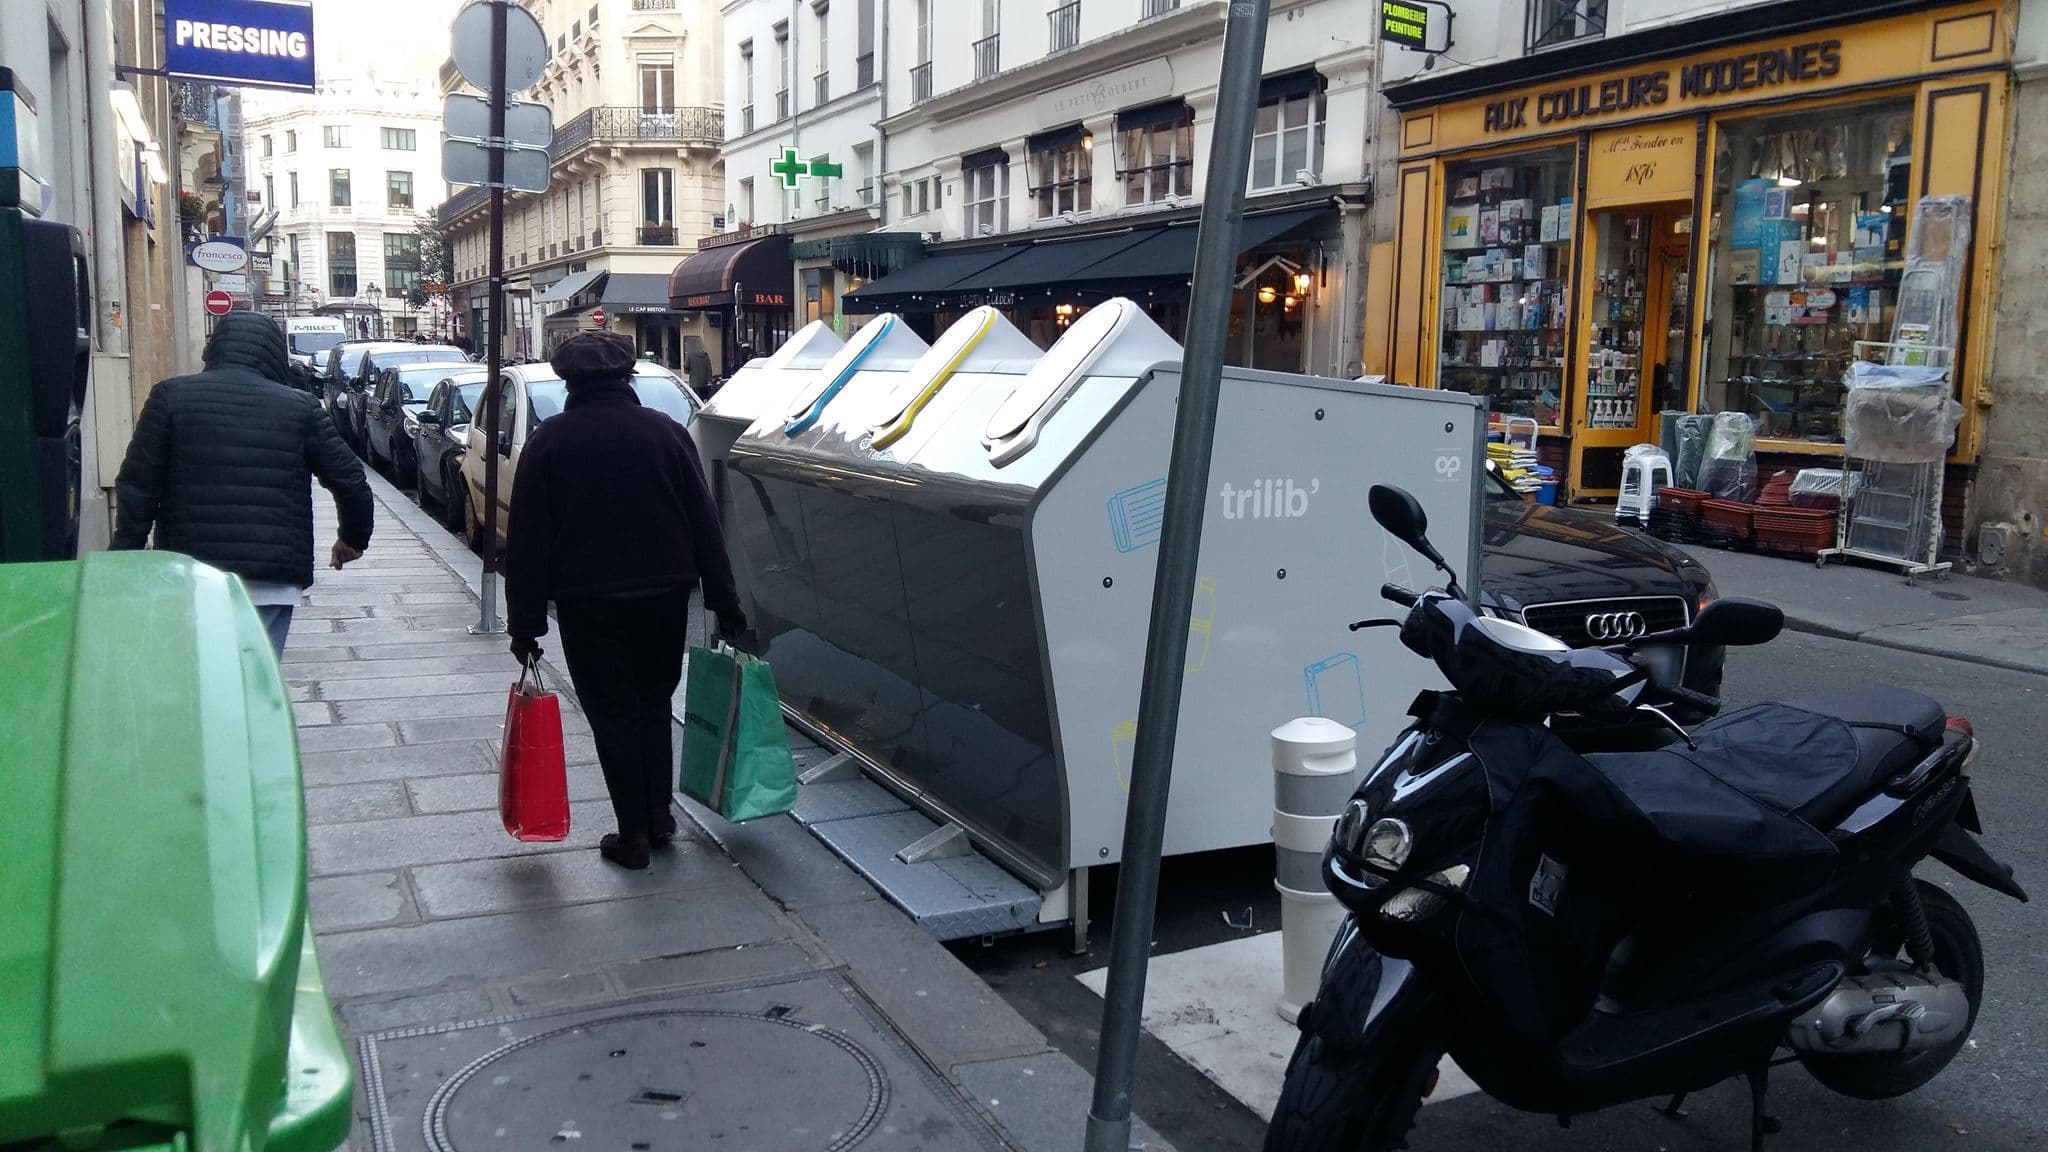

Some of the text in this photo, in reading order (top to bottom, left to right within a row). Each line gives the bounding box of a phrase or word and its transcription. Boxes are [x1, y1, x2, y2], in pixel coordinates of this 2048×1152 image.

[1383, 2, 1426, 24] PLOMBERIE
[175, 19, 307, 58] PRESSING
[1385, 18, 1423, 39] PEINTURE
[1055, 103, 1064, 112] LE
[1102, 77, 1146, 97] COLBERT
[1484, 40, 1842, 132] AUX COULEURS MODERNES
[1670, 136, 1684, 146] en
[1624, 161, 1657, 185] 1876
[197, 248, 243, 260] francesca
[755, 293, 785, 305] BAR
